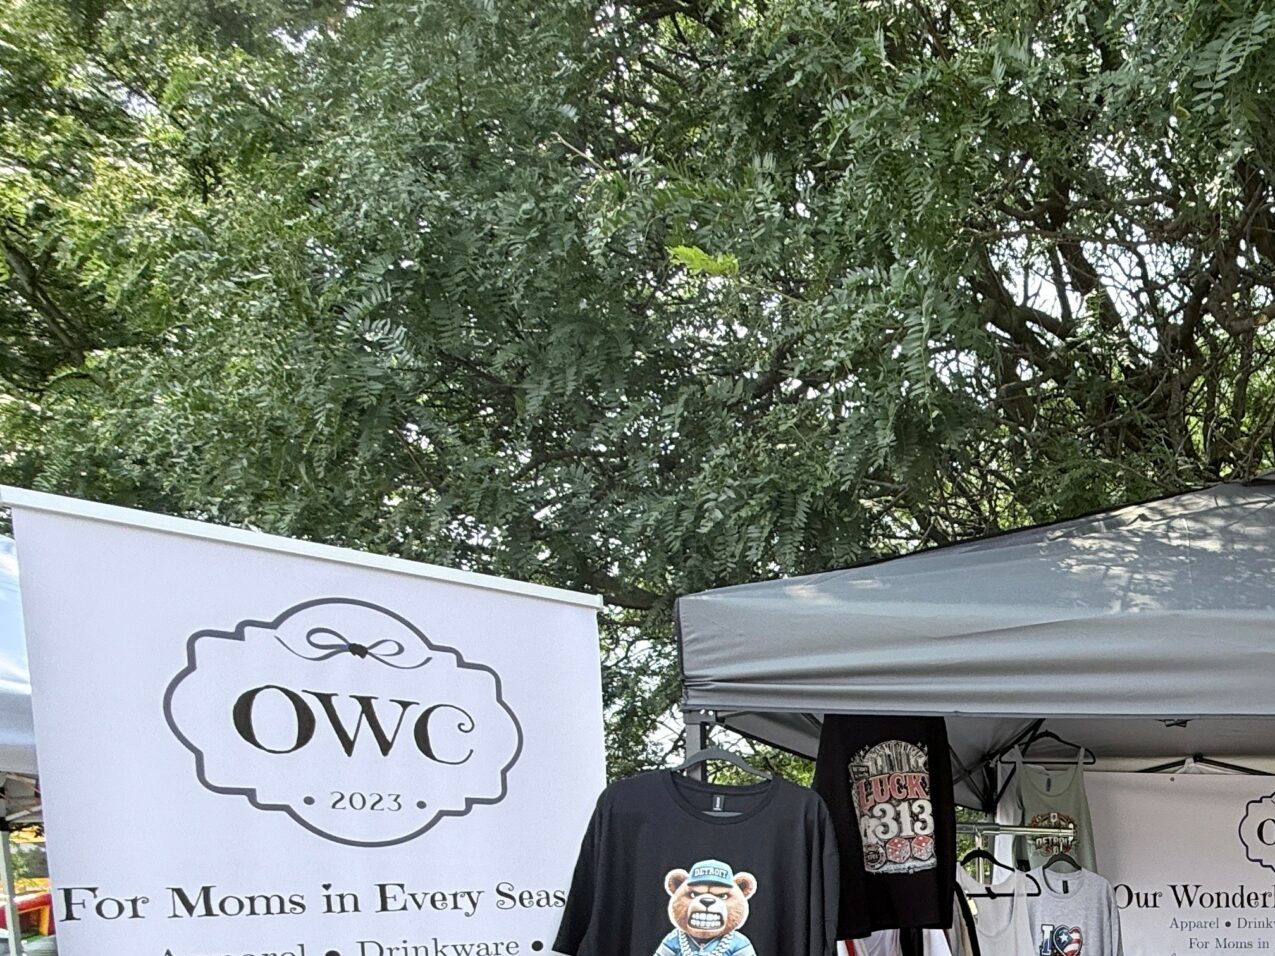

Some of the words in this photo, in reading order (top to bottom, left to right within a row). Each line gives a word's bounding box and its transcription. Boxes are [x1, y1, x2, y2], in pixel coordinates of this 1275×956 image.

[232, 685, 475, 766] OWC
[331, 791, 402, 812] 2023
[872, 799, 935, 840] 313
[58, 886, 150, 923] For
[167, 885, 307, 919] Moms
[322, 883, 361, 914] in
[375, 883, 485, 917] Every
[1113, 883, 1163, 910] Our
[1169, 916, 1219, 931] Apparel
[1189, 937, 1210, 949] For
[1215, 937, 1253, 949] Moms
[1257, 937, 1270, 949] in
